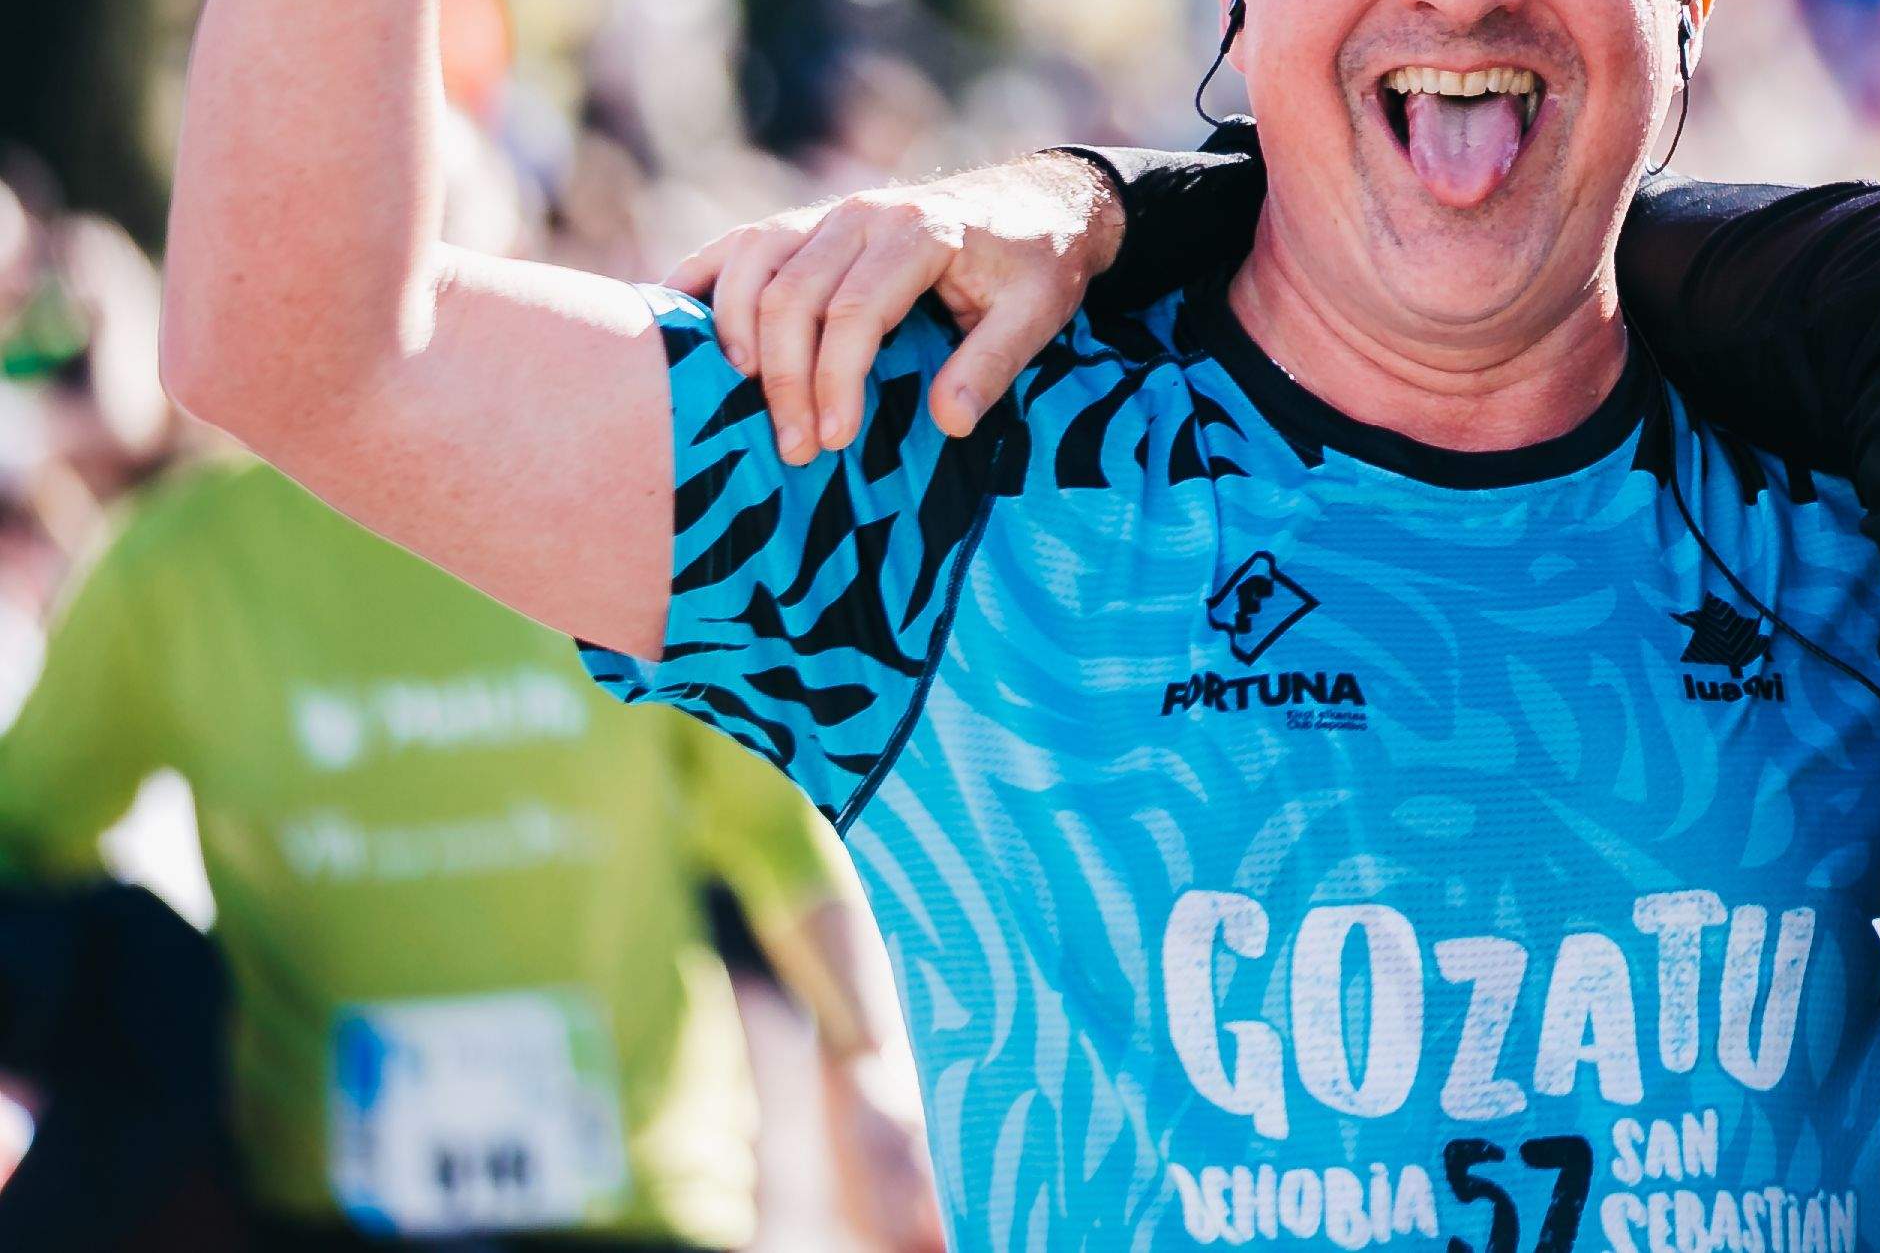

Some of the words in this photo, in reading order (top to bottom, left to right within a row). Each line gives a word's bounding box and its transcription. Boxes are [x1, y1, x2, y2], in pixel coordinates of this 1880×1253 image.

[1160, 671, 1367, 716] FORTUNA
[1162, 889, 1816, 1140] GOZATU
[1443, 1135, 1595, 1253] 57
[1611, 1109, 1720, 1187] SAN
